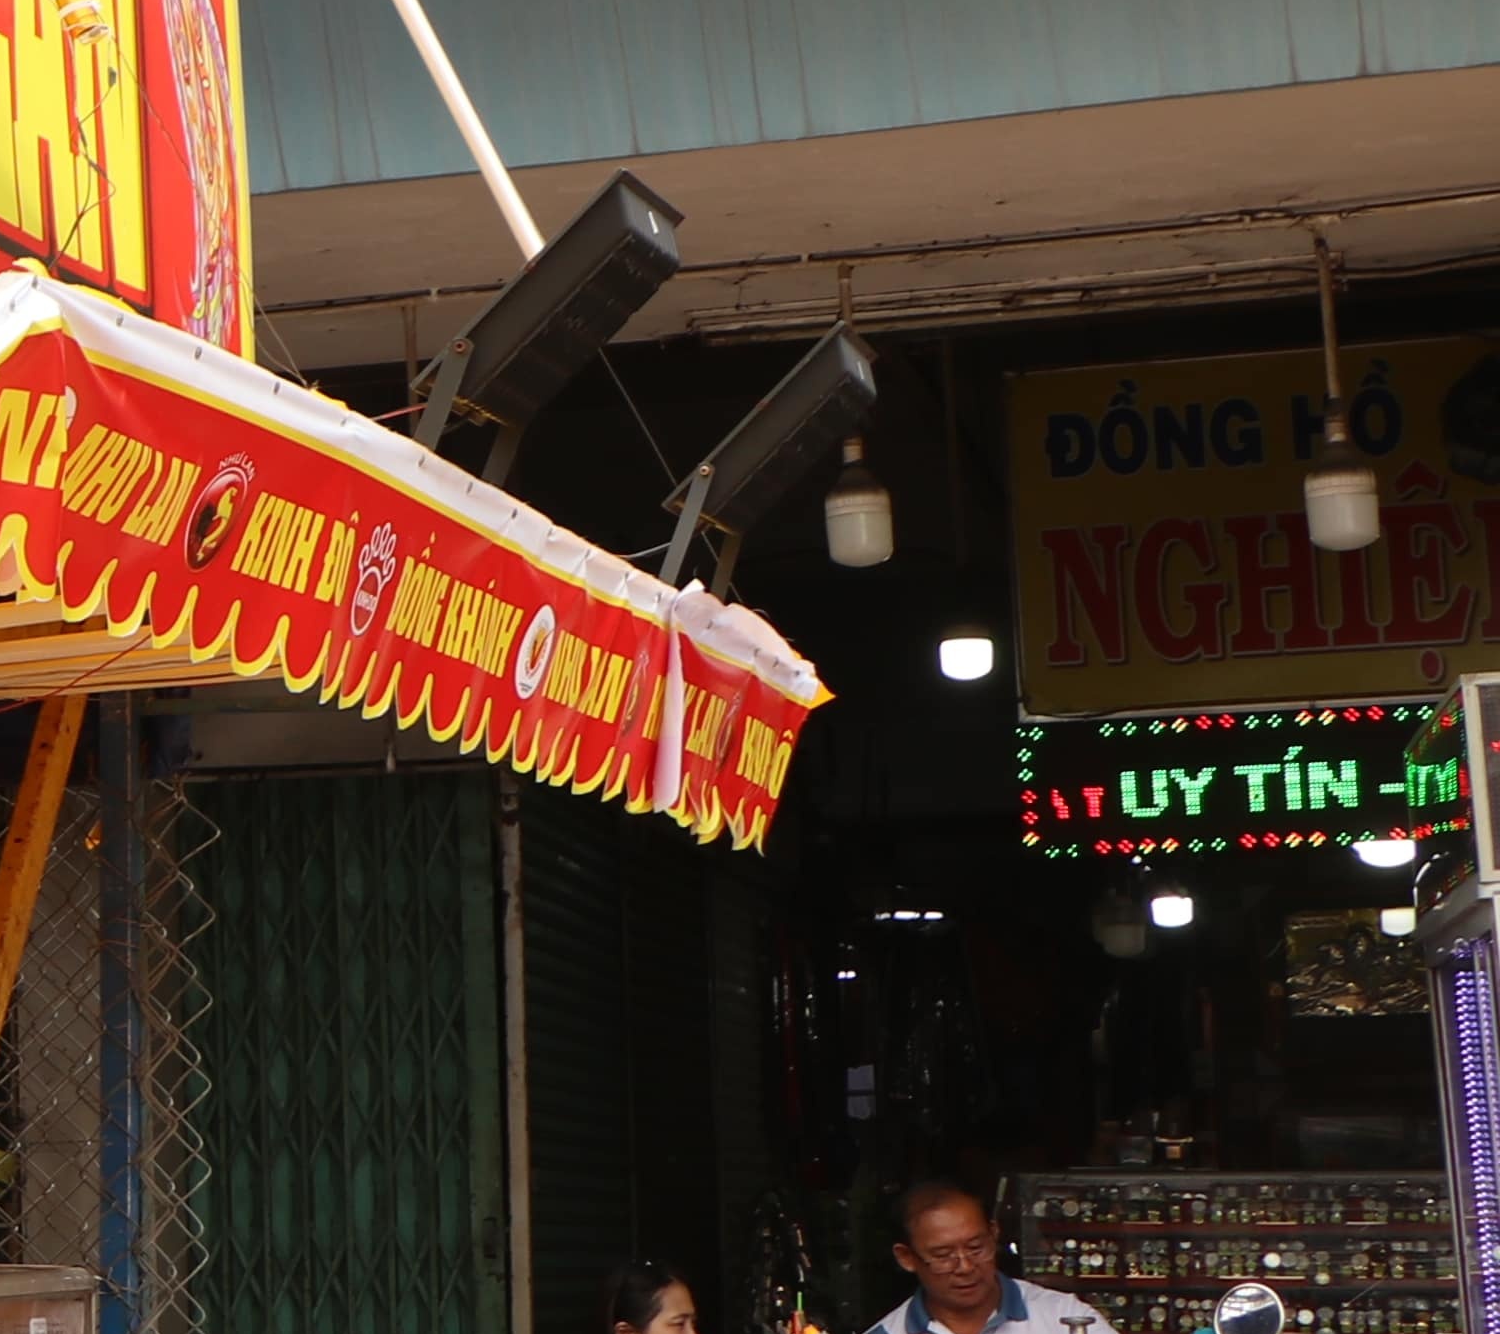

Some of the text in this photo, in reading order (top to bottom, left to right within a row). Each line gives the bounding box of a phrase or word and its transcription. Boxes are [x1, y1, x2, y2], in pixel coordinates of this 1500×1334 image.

[1045, 357, 1402, 481] ĐỒNG HỒ
[120, 449, 202, 547] LAN
[230, 489, 360, 607] KINH ĐÔ
[384, 531, 524, 679] ĐỒNG KHÁNH
[1041, 458, 1500, 684] NGHIỆ
[1119, 766, 1218, 818] UY
[1232, 744, 1360, 815] TÍN
